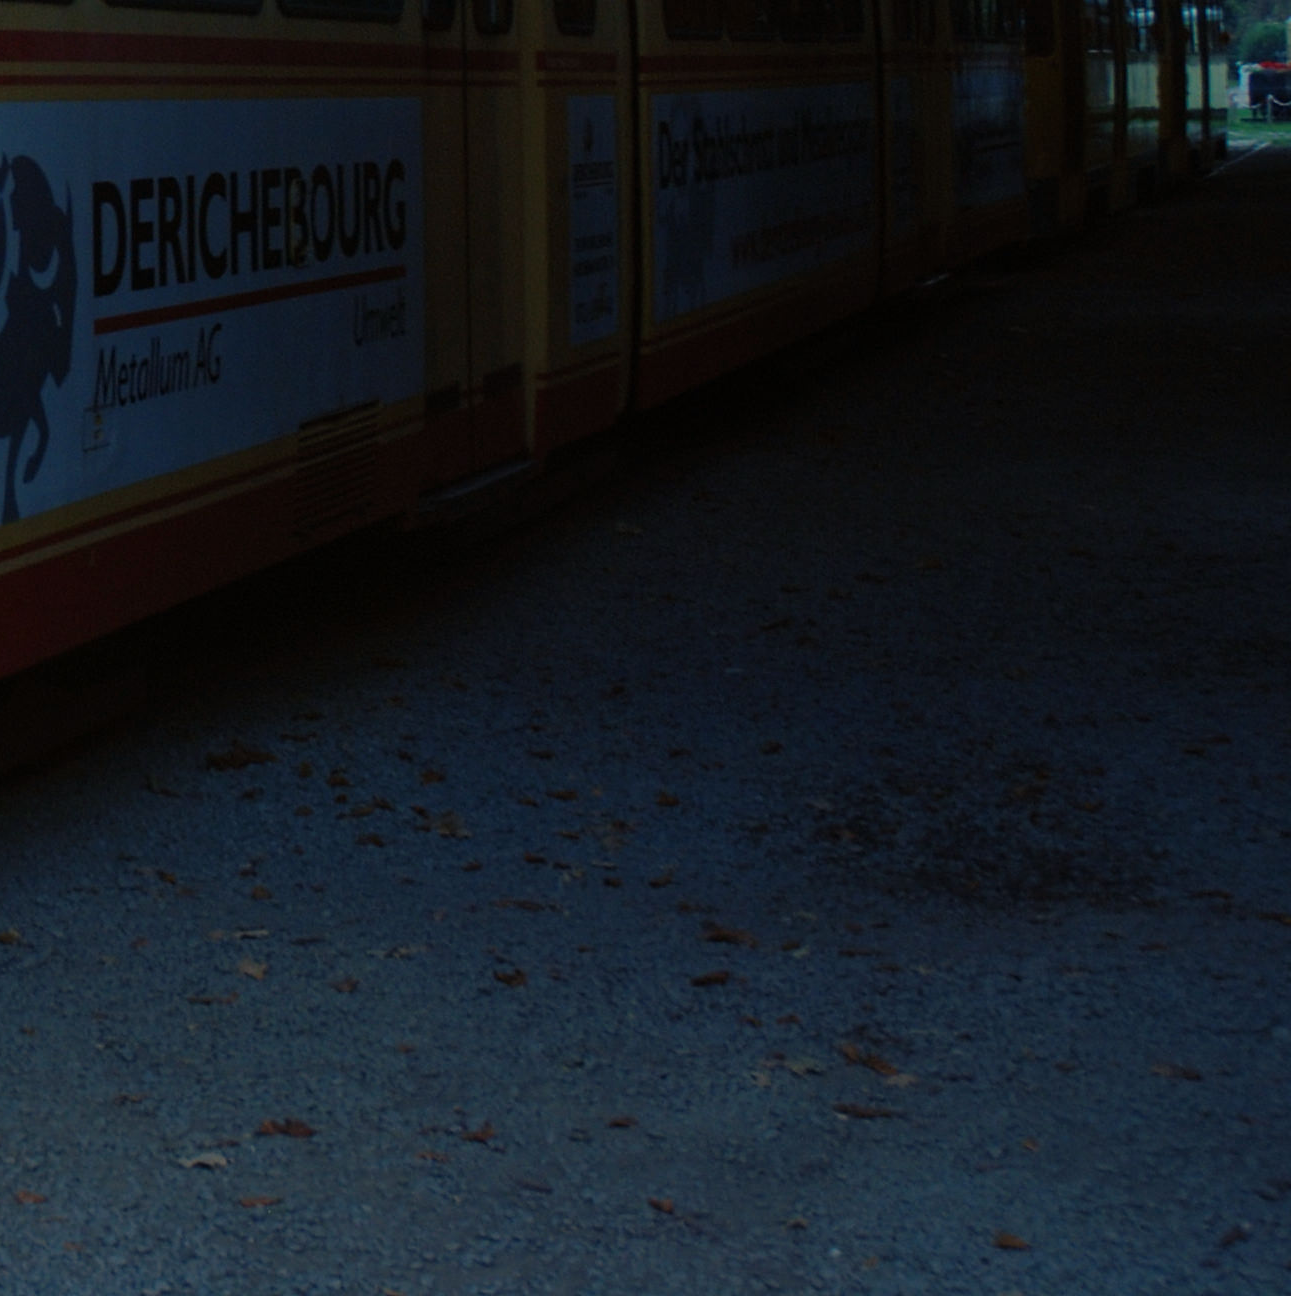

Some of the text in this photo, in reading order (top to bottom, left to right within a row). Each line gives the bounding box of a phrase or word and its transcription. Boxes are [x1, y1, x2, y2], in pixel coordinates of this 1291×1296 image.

[92, 159, 407, 297] DERICHEBOURG
[94, 323, 222, 411] Metallum AG
